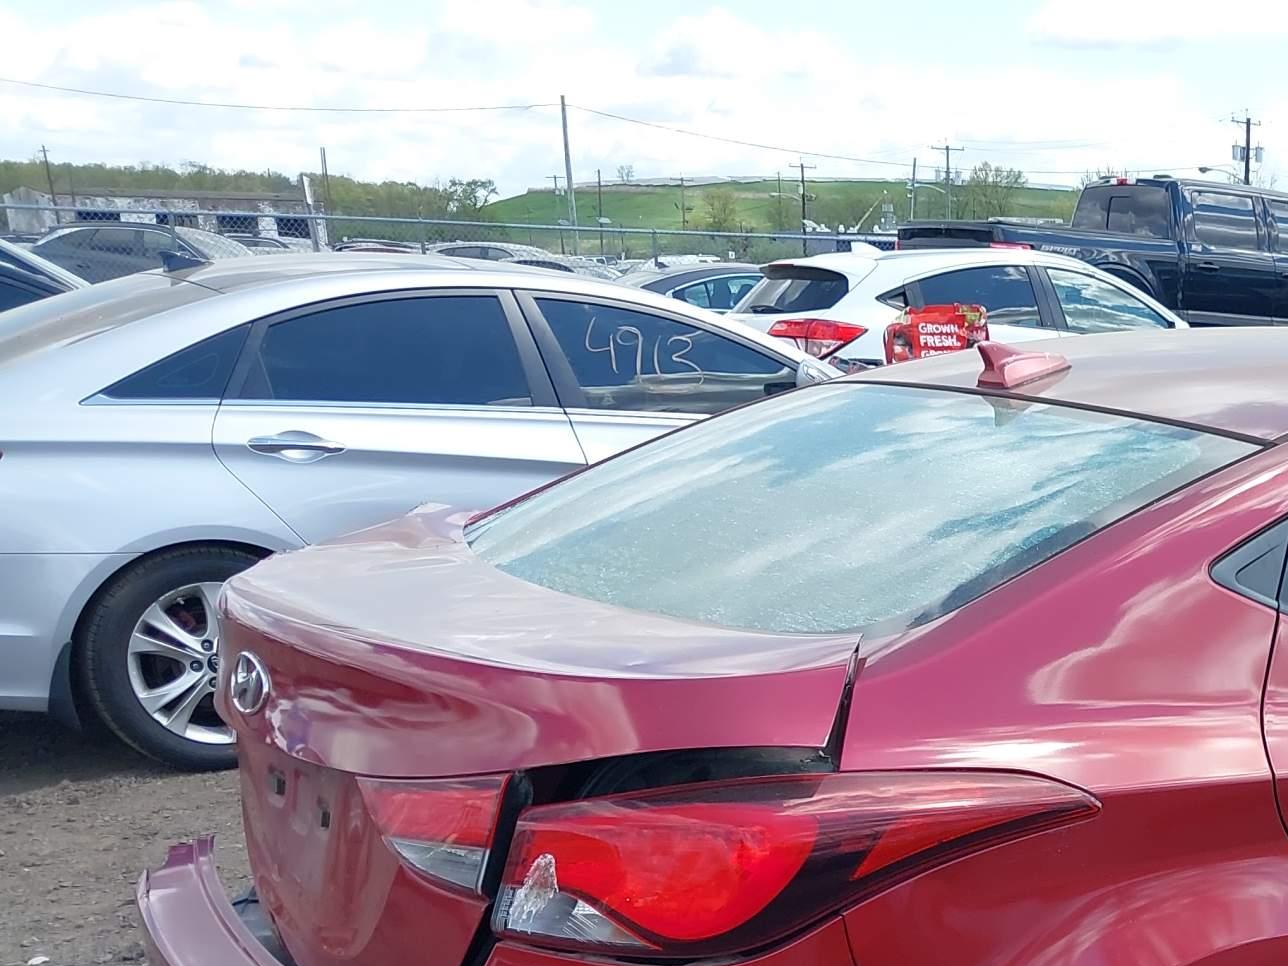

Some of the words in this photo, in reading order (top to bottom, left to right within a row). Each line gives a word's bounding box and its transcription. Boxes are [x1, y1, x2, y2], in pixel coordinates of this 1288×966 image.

[918, 322, 959, 333] GROWN
[919, 334, 961, 347] FRESH.
[585, 316, 705, 386] 4913
